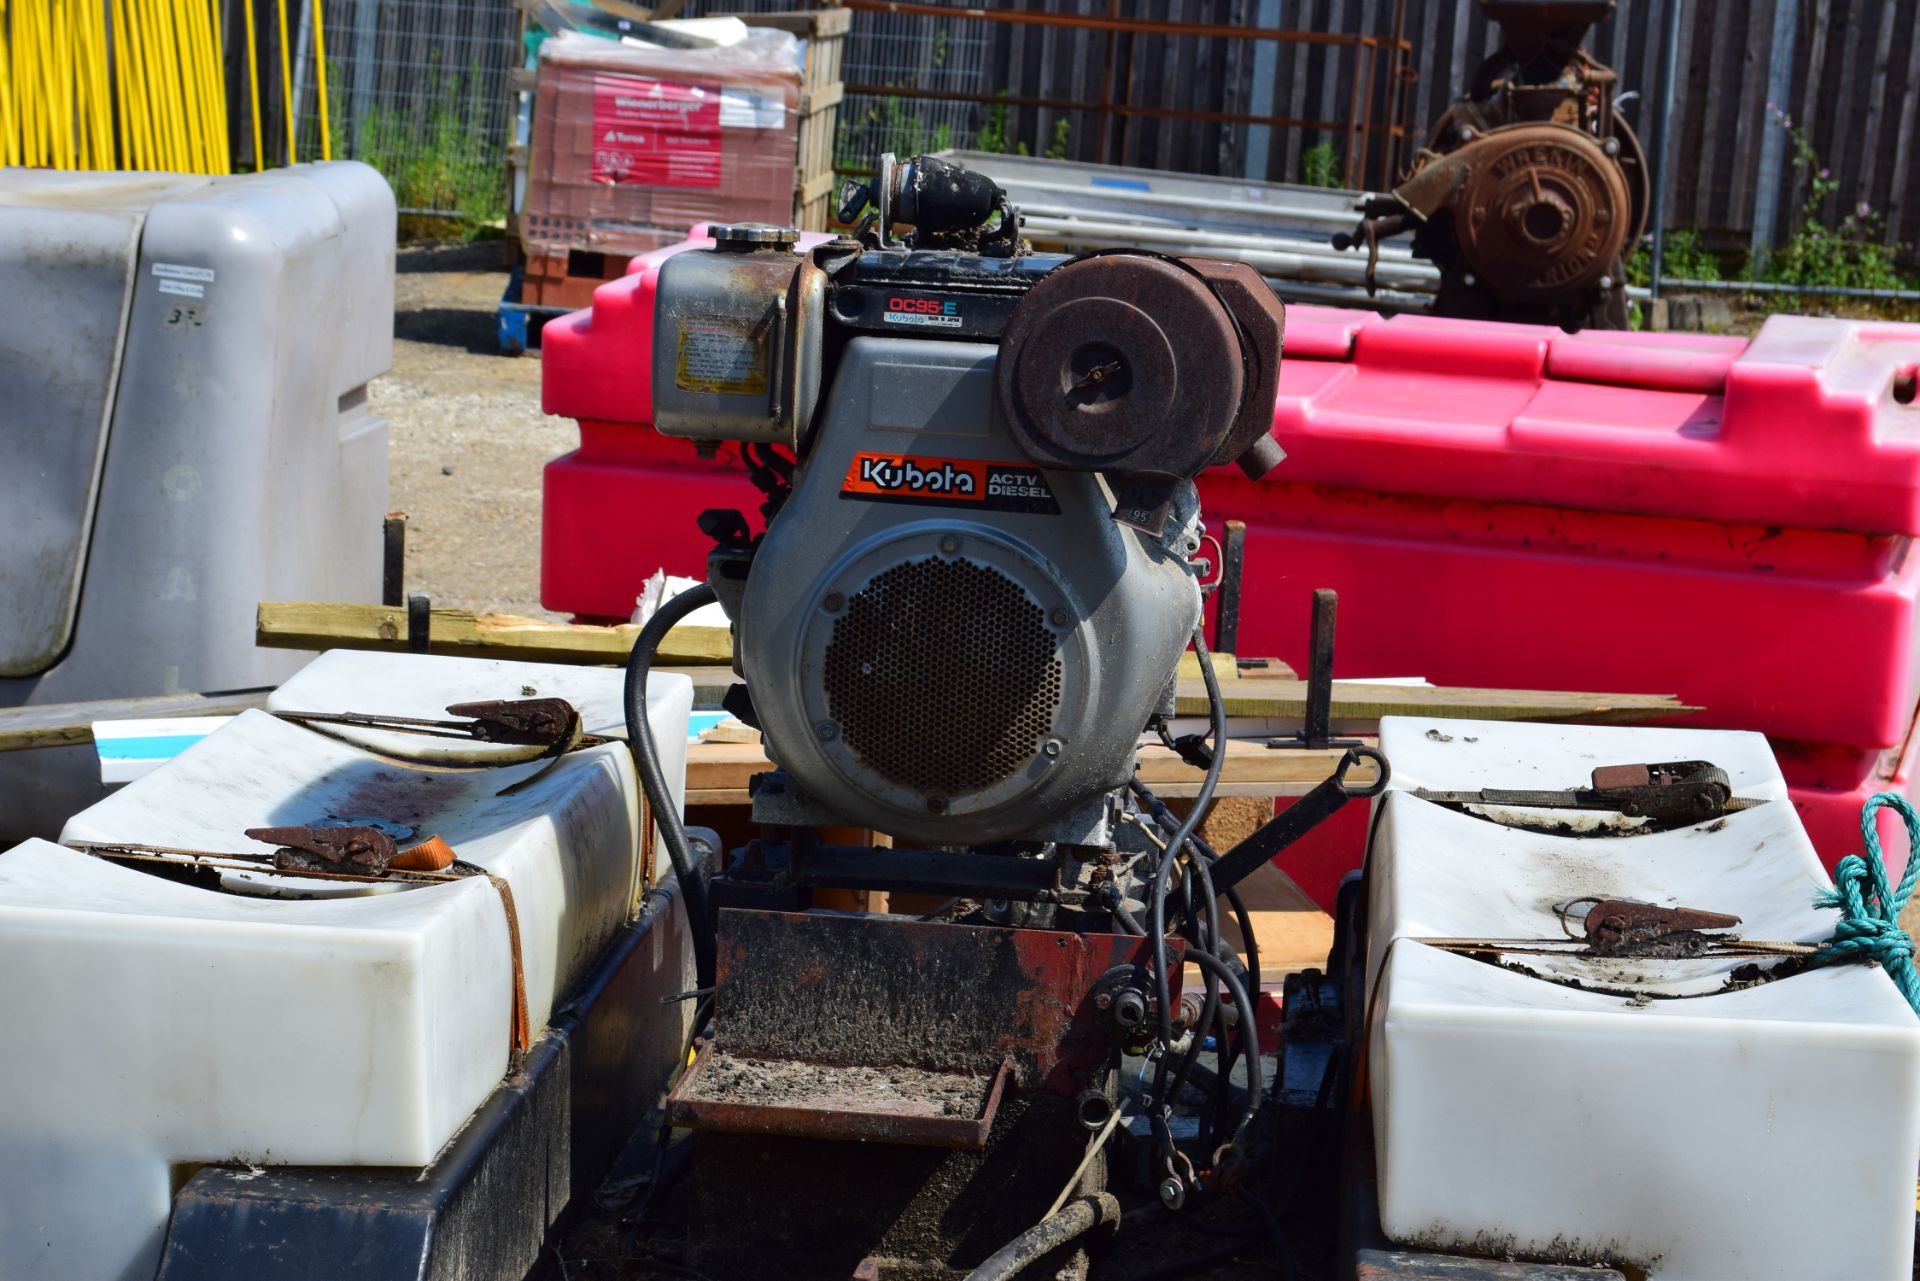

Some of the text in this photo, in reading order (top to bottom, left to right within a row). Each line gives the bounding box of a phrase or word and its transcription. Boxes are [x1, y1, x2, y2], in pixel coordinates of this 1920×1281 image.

[862, 459, 974, 493] Kubota
[988, 473, 1038, 486] ACTV
[988, 485, 1051, 499] DIESEL
[1133, 510, 1148, 522] 95
